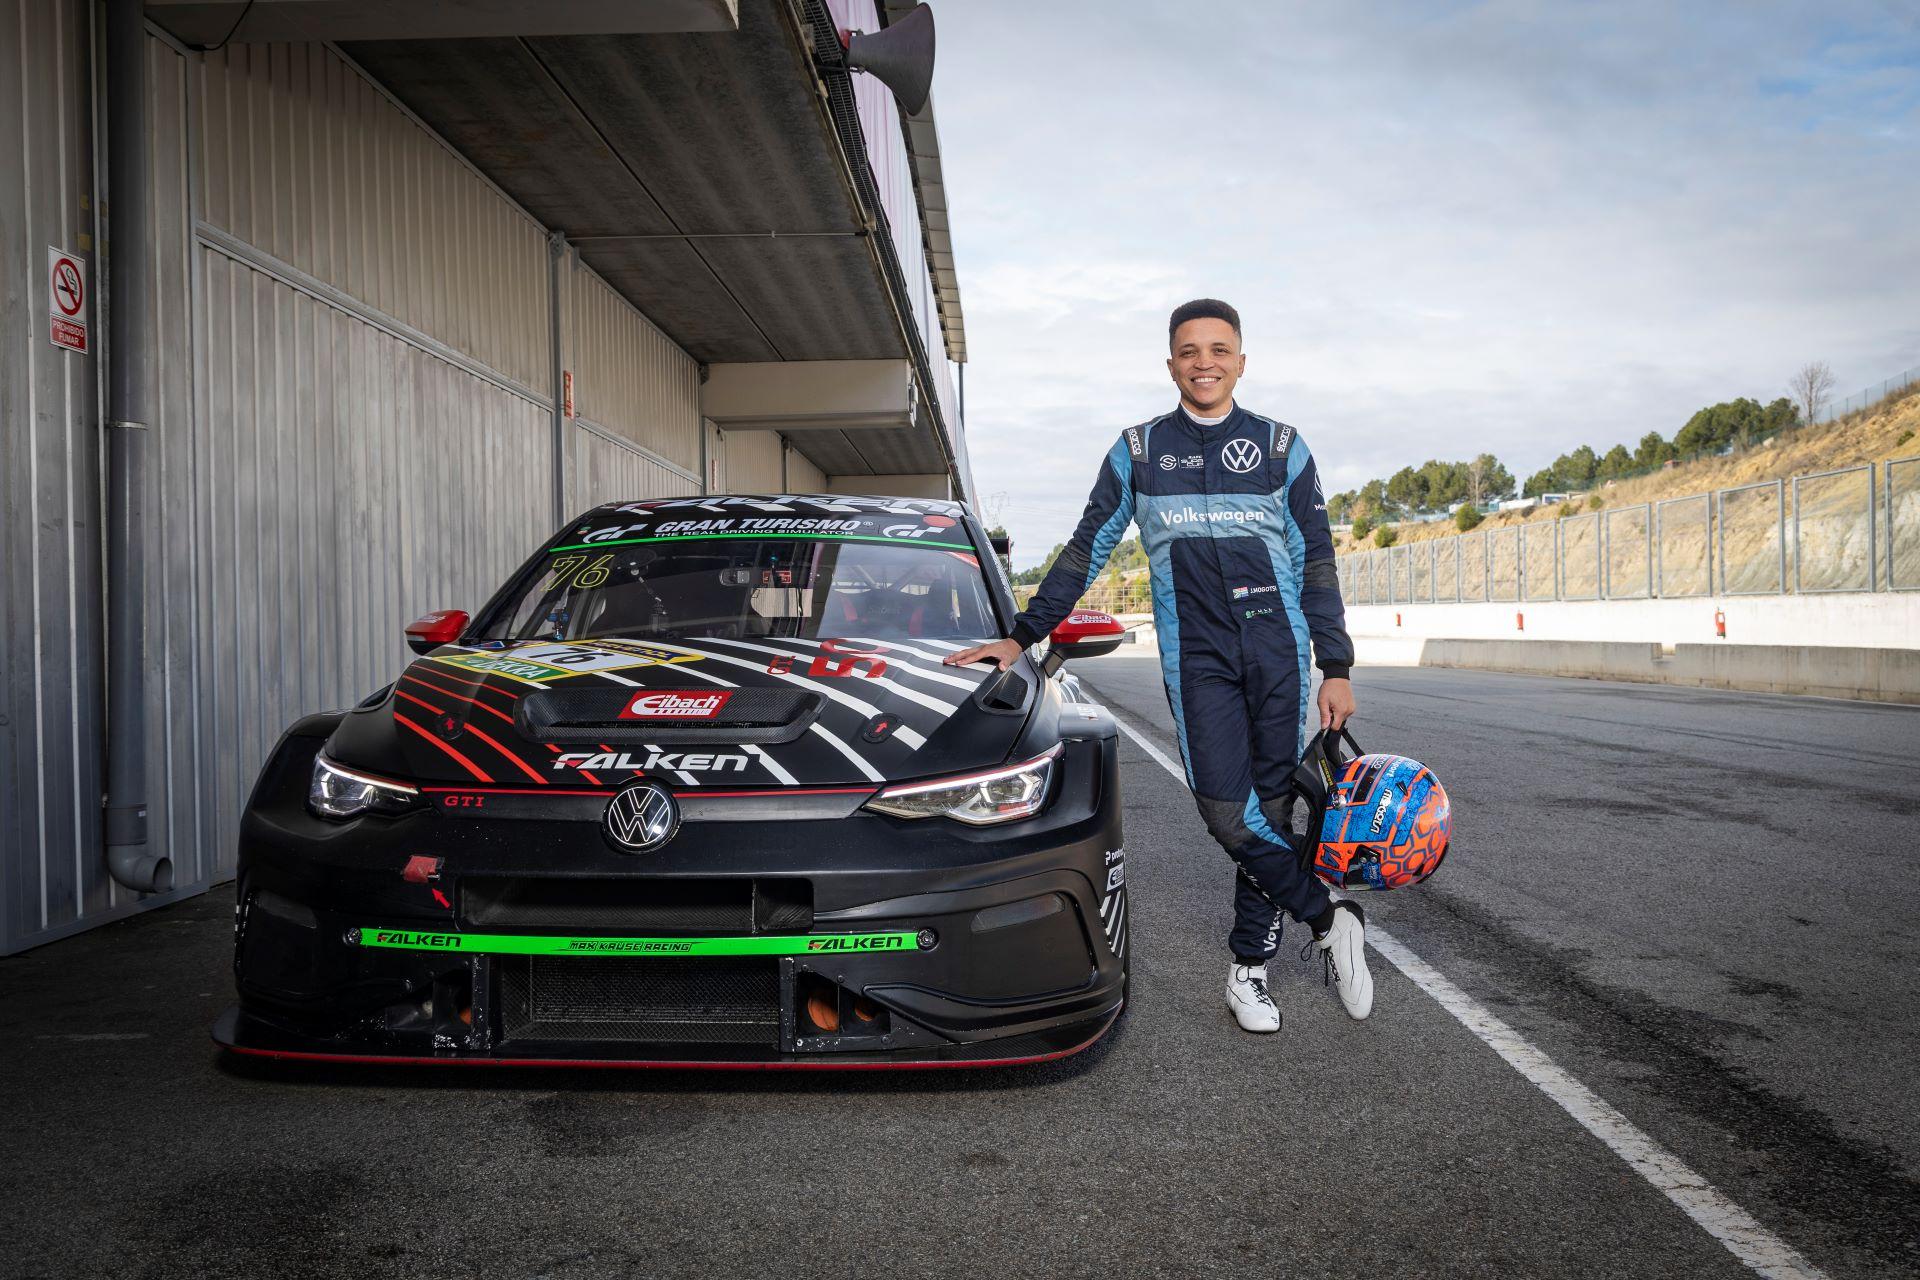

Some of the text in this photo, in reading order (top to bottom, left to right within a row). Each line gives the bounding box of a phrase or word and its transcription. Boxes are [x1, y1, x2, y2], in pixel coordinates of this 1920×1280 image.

[52, 319, 84, 337] PROHIBIDO
[58, 332, 80, 346] FUMAR
[1127, 428, 1142, 455] sparco
[1276, 426, 1291, 453] sparco
[600, 496, 963, 517] FALKEN
[654, 517, 862, 533] GRAN TURISMO
[1160, 507, 1265, 526] Volkswagen
[540, 554, 615, 591] 76
[1067, 614, 1112, 624] Eibach
[528, 648, 615, 665] 76
[630, 694, 721, 715] Eibach
[550, 753, 749, 771] FALKEN
[443, 796, 485, 807] GTI
[376, 932, 462, 947] FALKEN
[569, 941, 597, 950] MAX
[643, 942, 691, 952] RACING
[807, 936, 903, 950] FALKEN
